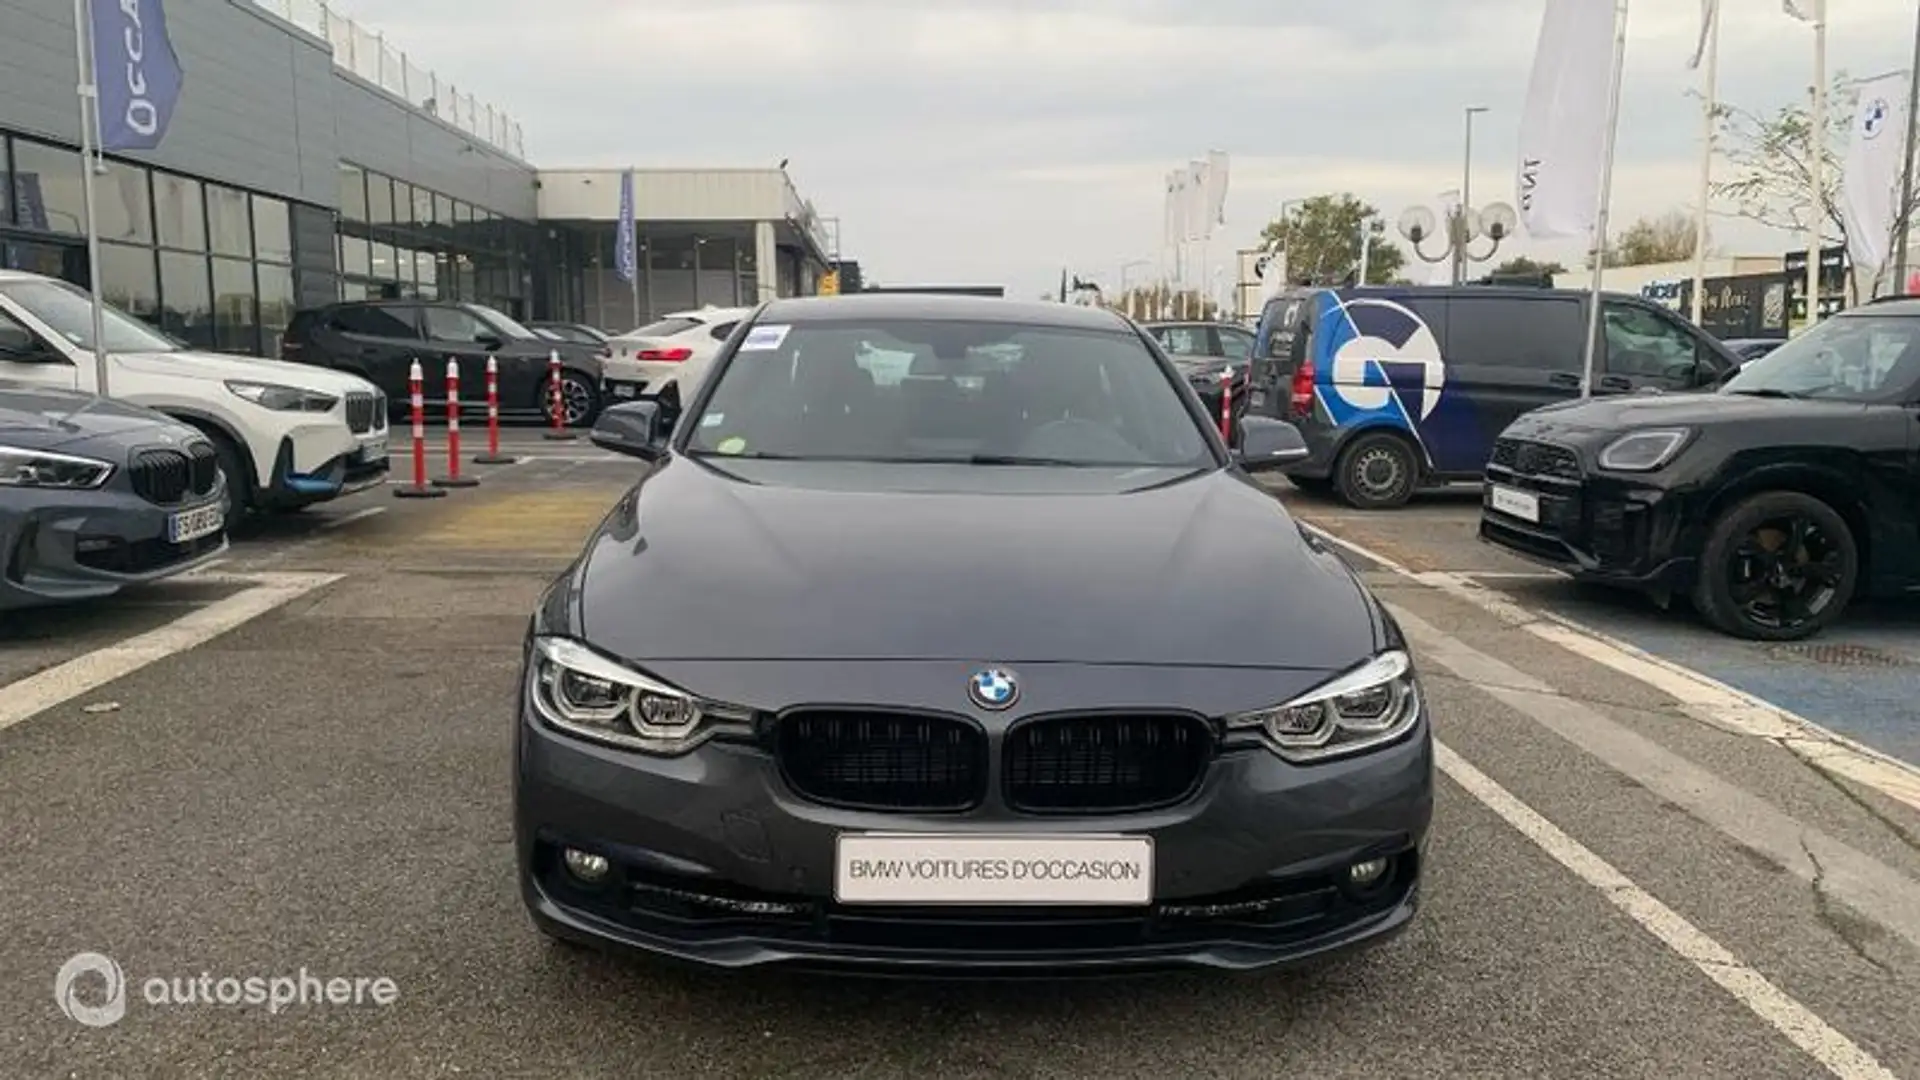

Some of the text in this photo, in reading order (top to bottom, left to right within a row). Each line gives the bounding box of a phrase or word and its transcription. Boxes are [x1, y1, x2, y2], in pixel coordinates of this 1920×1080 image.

[850, 859, 1141, 880] BMW VOITURES D'OCCASION
